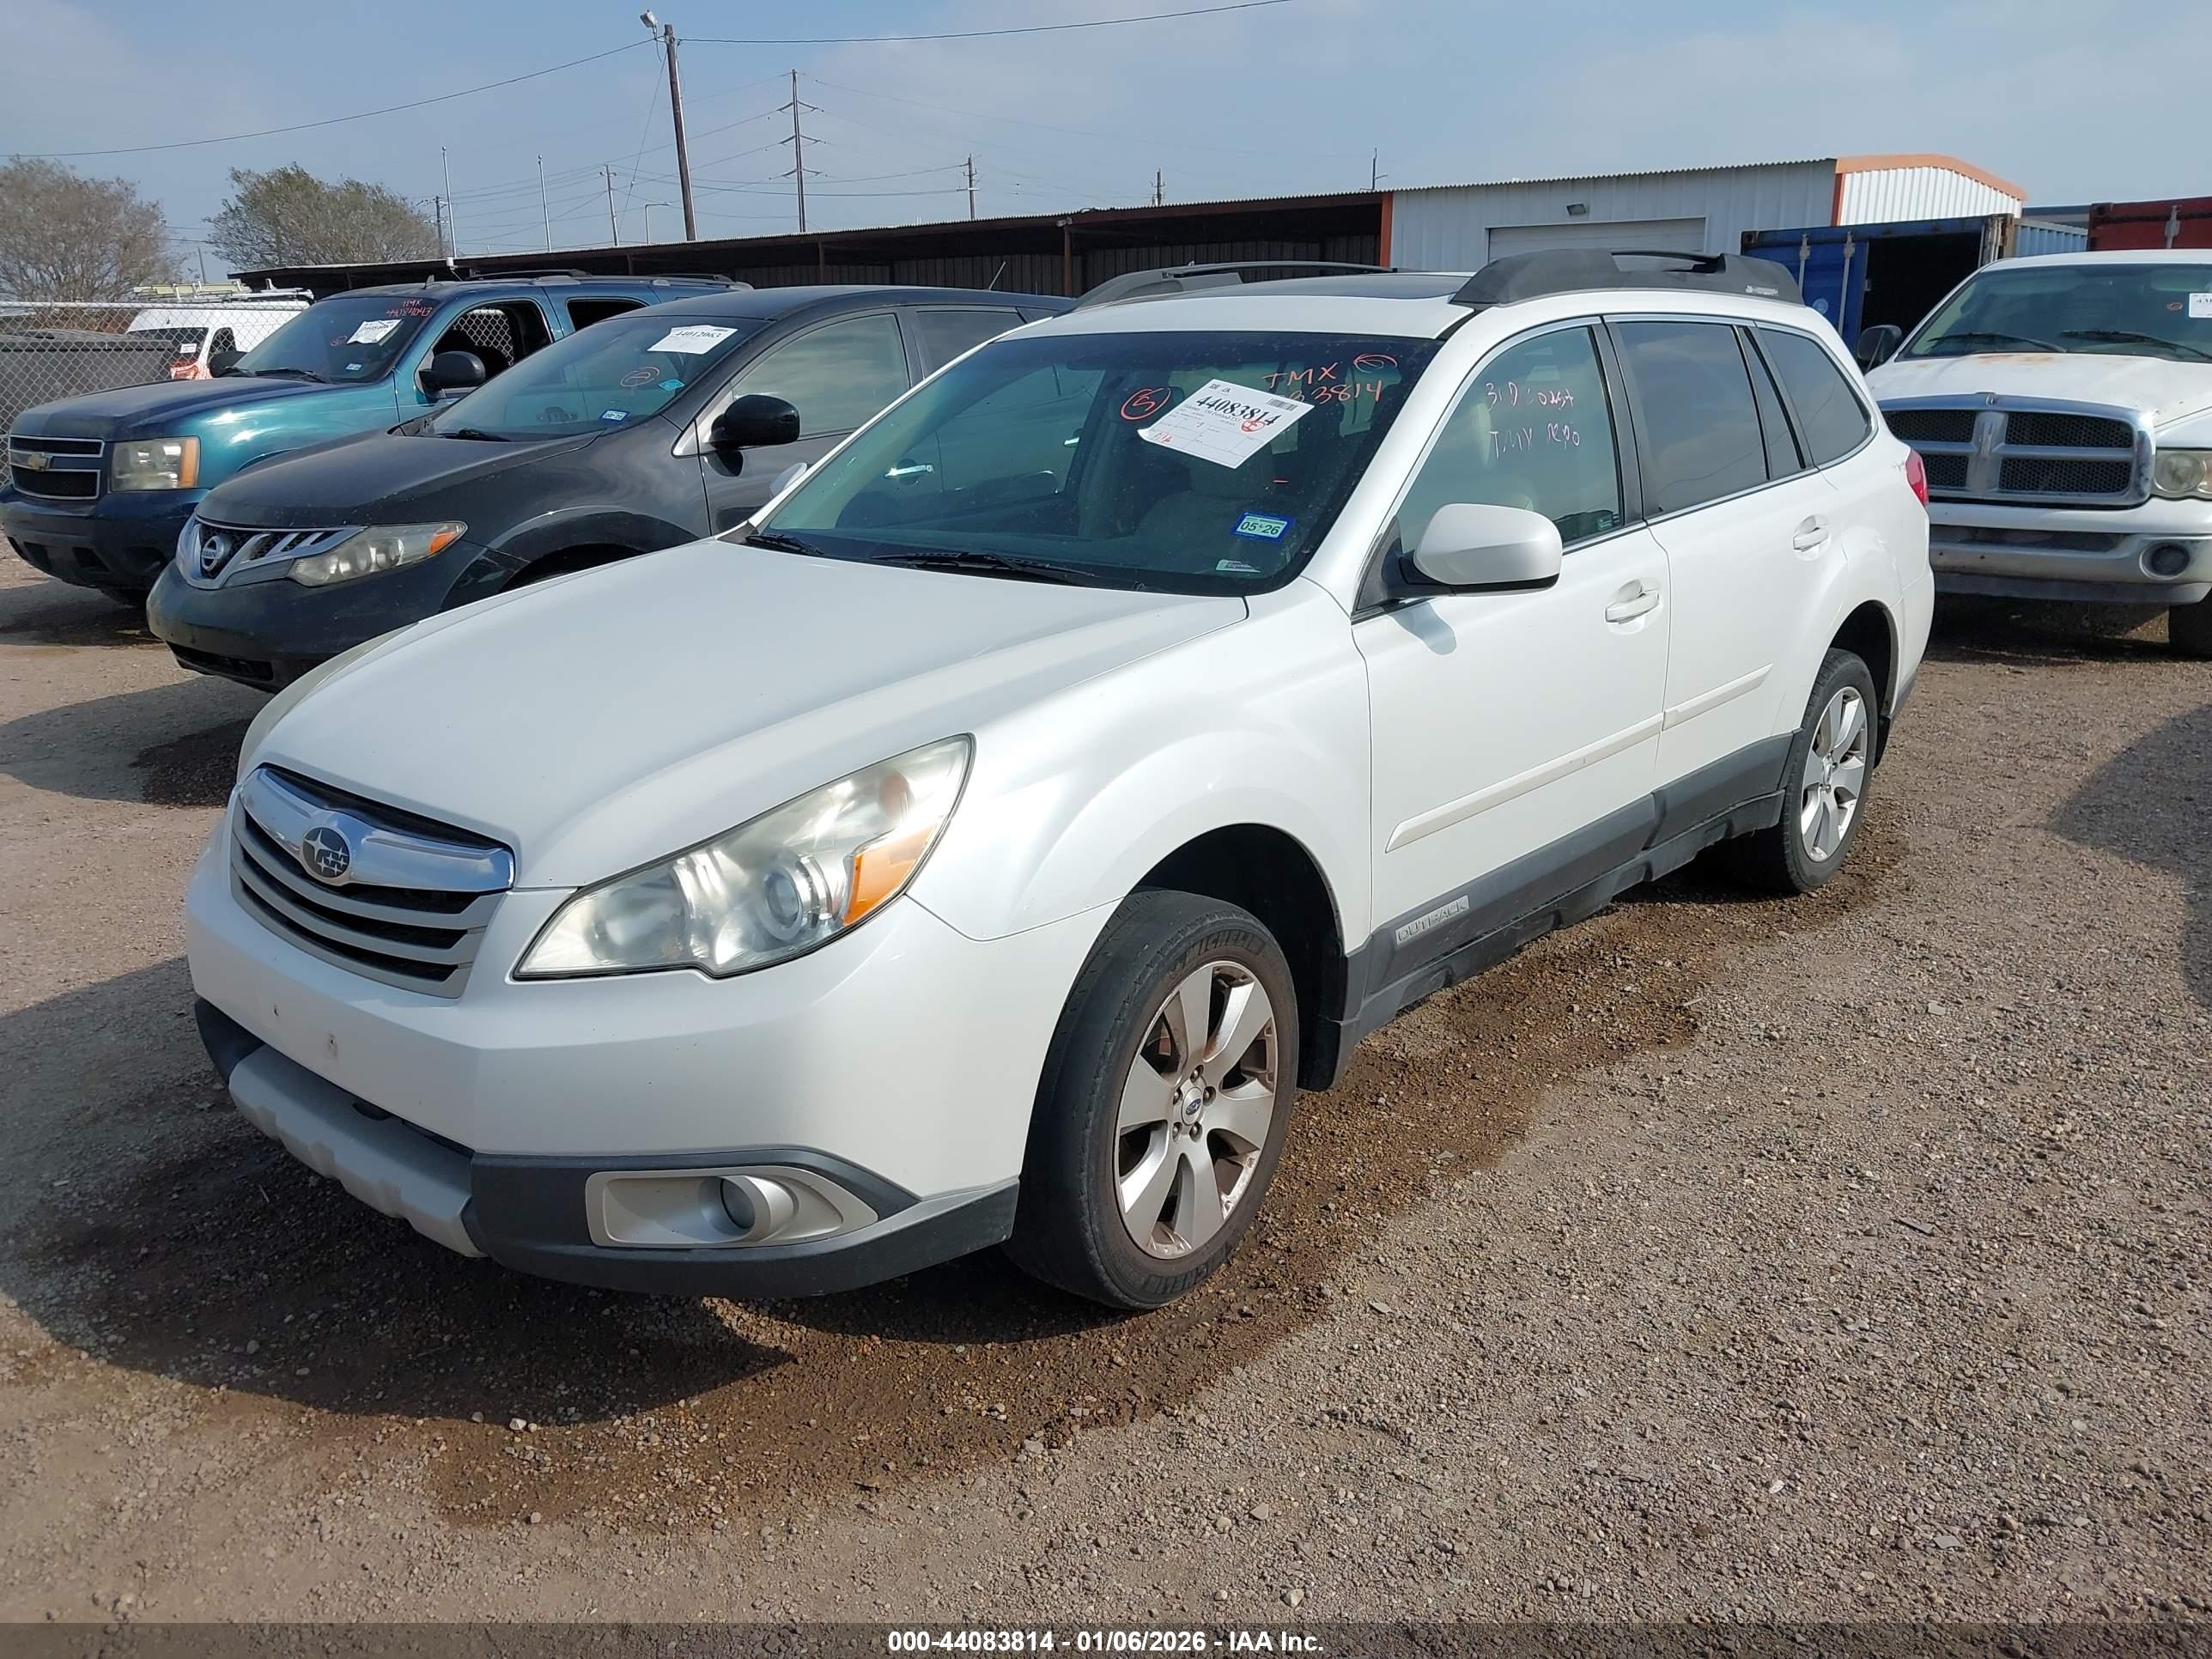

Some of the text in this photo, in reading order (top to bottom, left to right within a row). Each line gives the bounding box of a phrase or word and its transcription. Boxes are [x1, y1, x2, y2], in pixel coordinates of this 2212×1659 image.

[1196, 396, 1282, 426] 44083814
[1241, 521, 1281, 535] 05 26
[1398, 897, 1468, 942] OUTBACK
